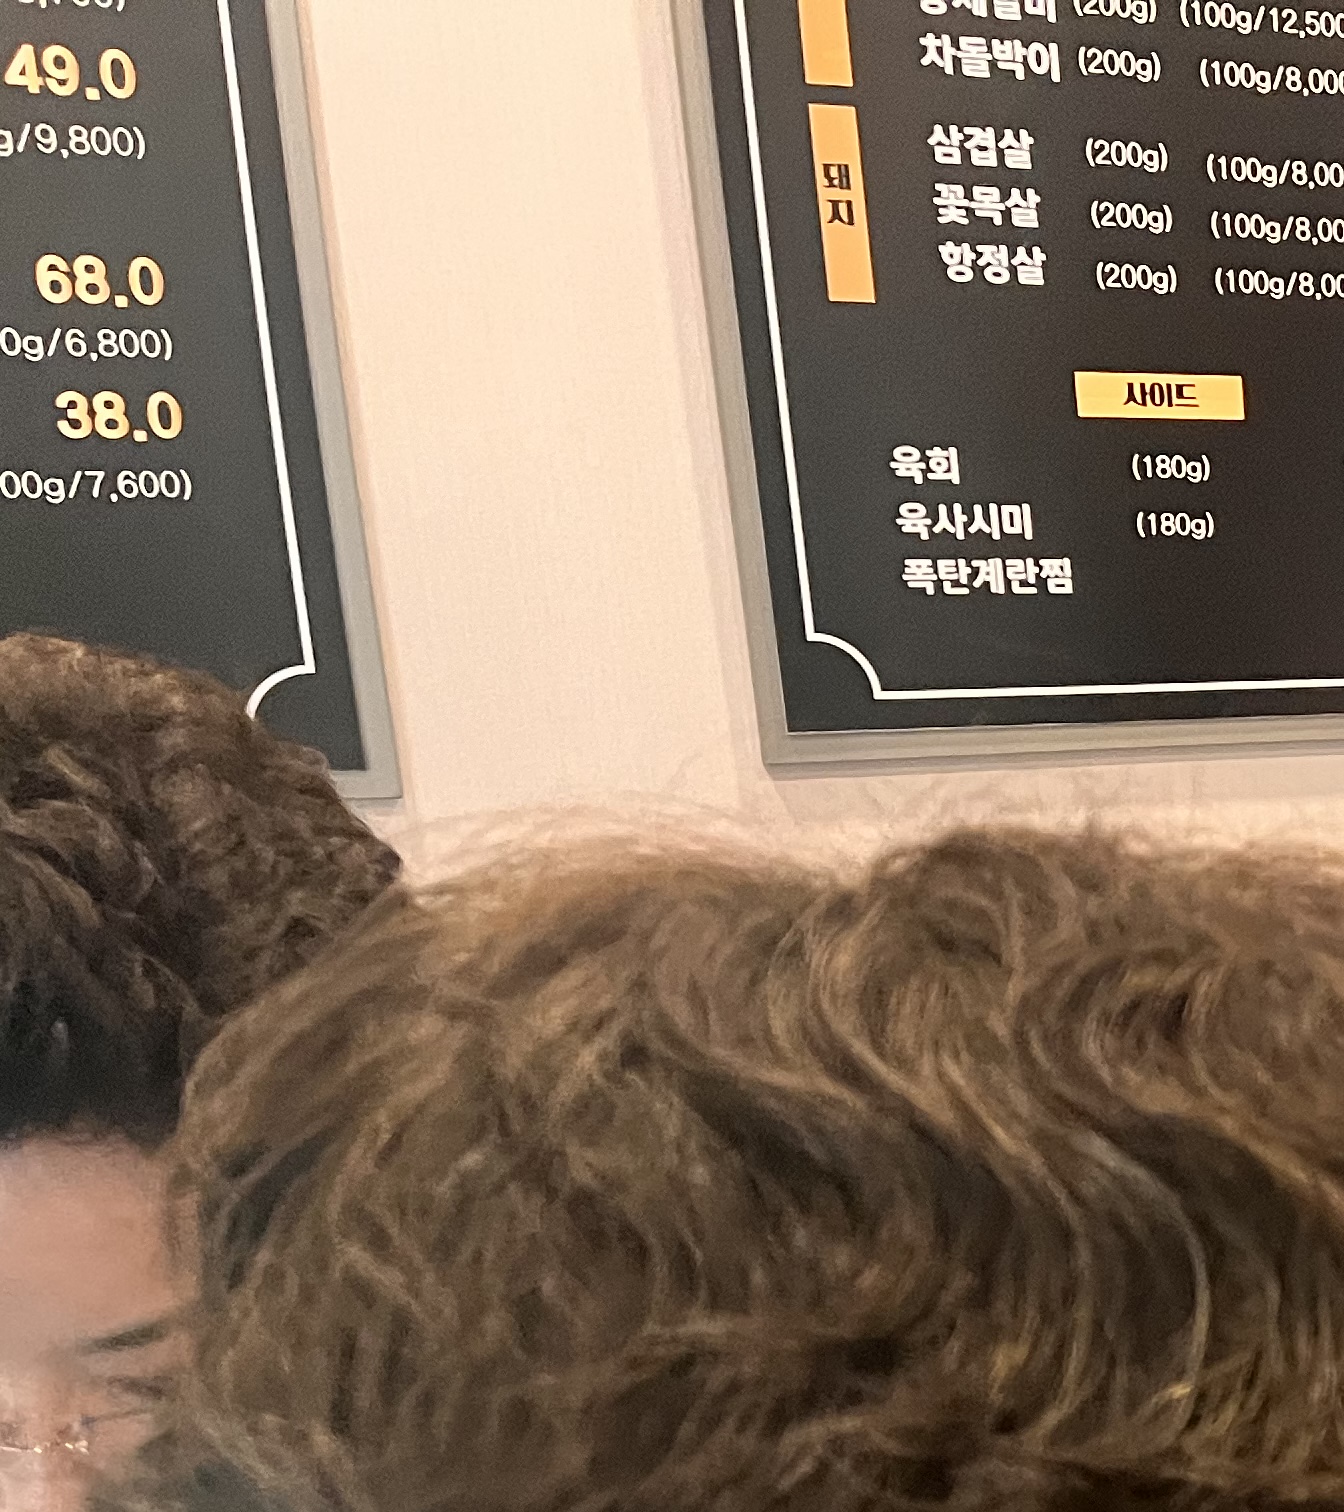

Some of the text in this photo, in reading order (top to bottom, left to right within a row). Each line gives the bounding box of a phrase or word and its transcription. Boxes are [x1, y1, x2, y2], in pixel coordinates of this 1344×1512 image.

[4, 43, 137, 101] 49.0
[918, 32, 1061, 83] 차돌박이
[1078, 46, 1161, 83] (200g)
[926, 123, 1035, 170] 삼겹살
[1085, 137, 1168, 173] (200g)
[821, 163, 856, 228] 돼지
[932, 182, 1041, 228] 꽃목살
[1090, 200, 1173, 235] (200g)
[35, 254, 164, 308] 68.0
[938, 240, 1047, 286] 항정살
[1096, 261, 1177, 295] (200g)
[55, 390, 182, 442] 38.0
[1123, 382, 1200, 408] 사이드
[889, 445, 960, 485] 육회
[1132, 453, 1211, 483] (180g)
[895, 502, 1033, 541] 육사시미
[1136, 511, 1215, 540] (180g)
[901, 557, 1074, 596] 폭탄계란찜
